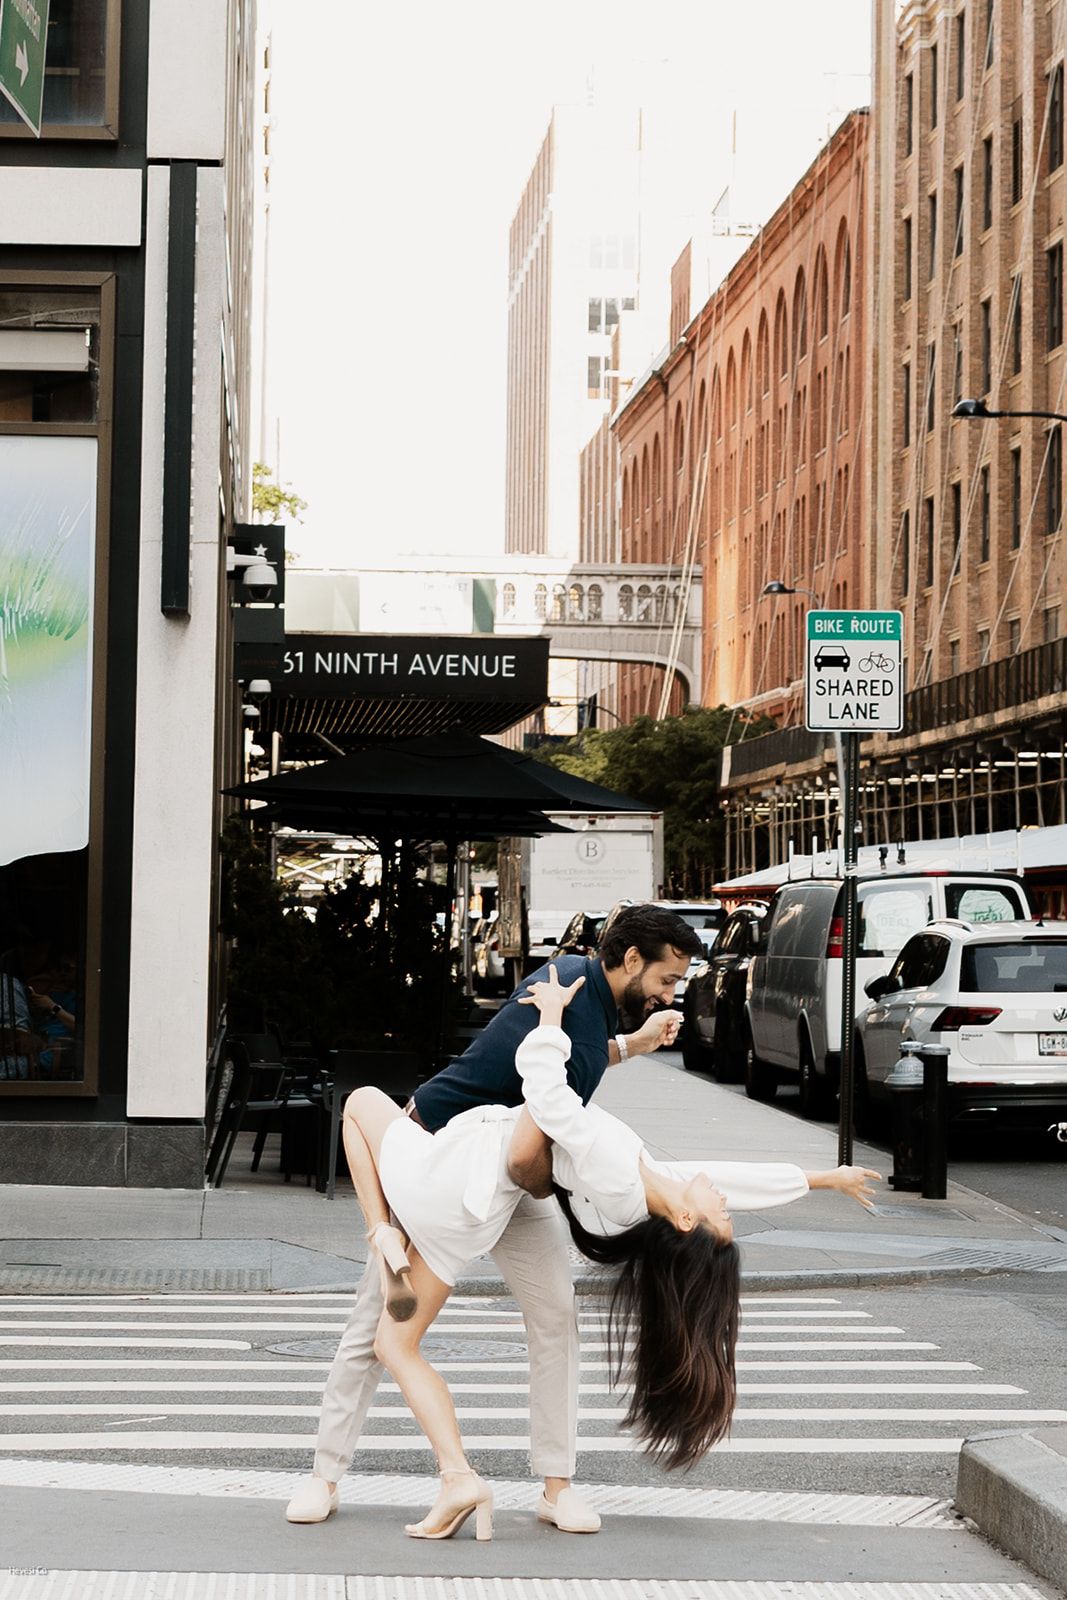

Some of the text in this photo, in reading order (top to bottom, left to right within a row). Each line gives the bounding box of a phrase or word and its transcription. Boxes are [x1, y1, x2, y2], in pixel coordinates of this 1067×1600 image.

[815, 619, 895, 634] BIKE ROUTE
[315, 652, 399, 676] NINTH
[407, 653, 516, 678] AVENUE
[815, 678, 894, 697] SHARED
[828, 702, 880, 720] LANE
[585, 840, 598, 858] B
